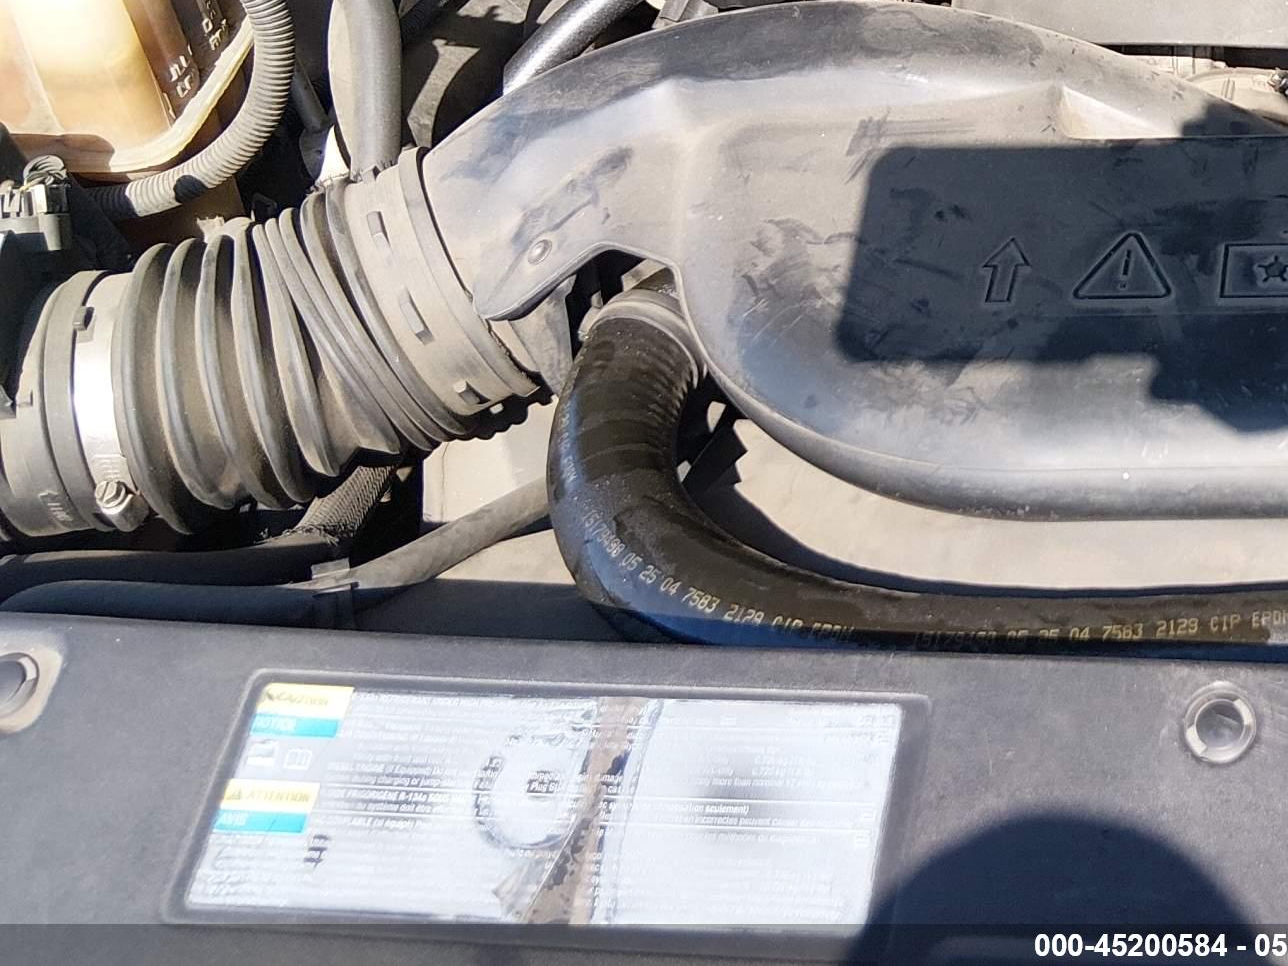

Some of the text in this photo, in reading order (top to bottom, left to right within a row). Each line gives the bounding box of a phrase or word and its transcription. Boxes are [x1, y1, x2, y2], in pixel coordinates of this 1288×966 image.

[622, 551, 643, 571] 05
[638, 564, 661, 584] 25
[660, 576, 682, 596] 04
[681, 586, 720, 613] 7583
[723, 603, 765, 627] 2129
[1103, 622, 1143, 640] 7583
[1155, 618, 1200, 637] 2129
[1209, 613, 1241, 632] CIP
